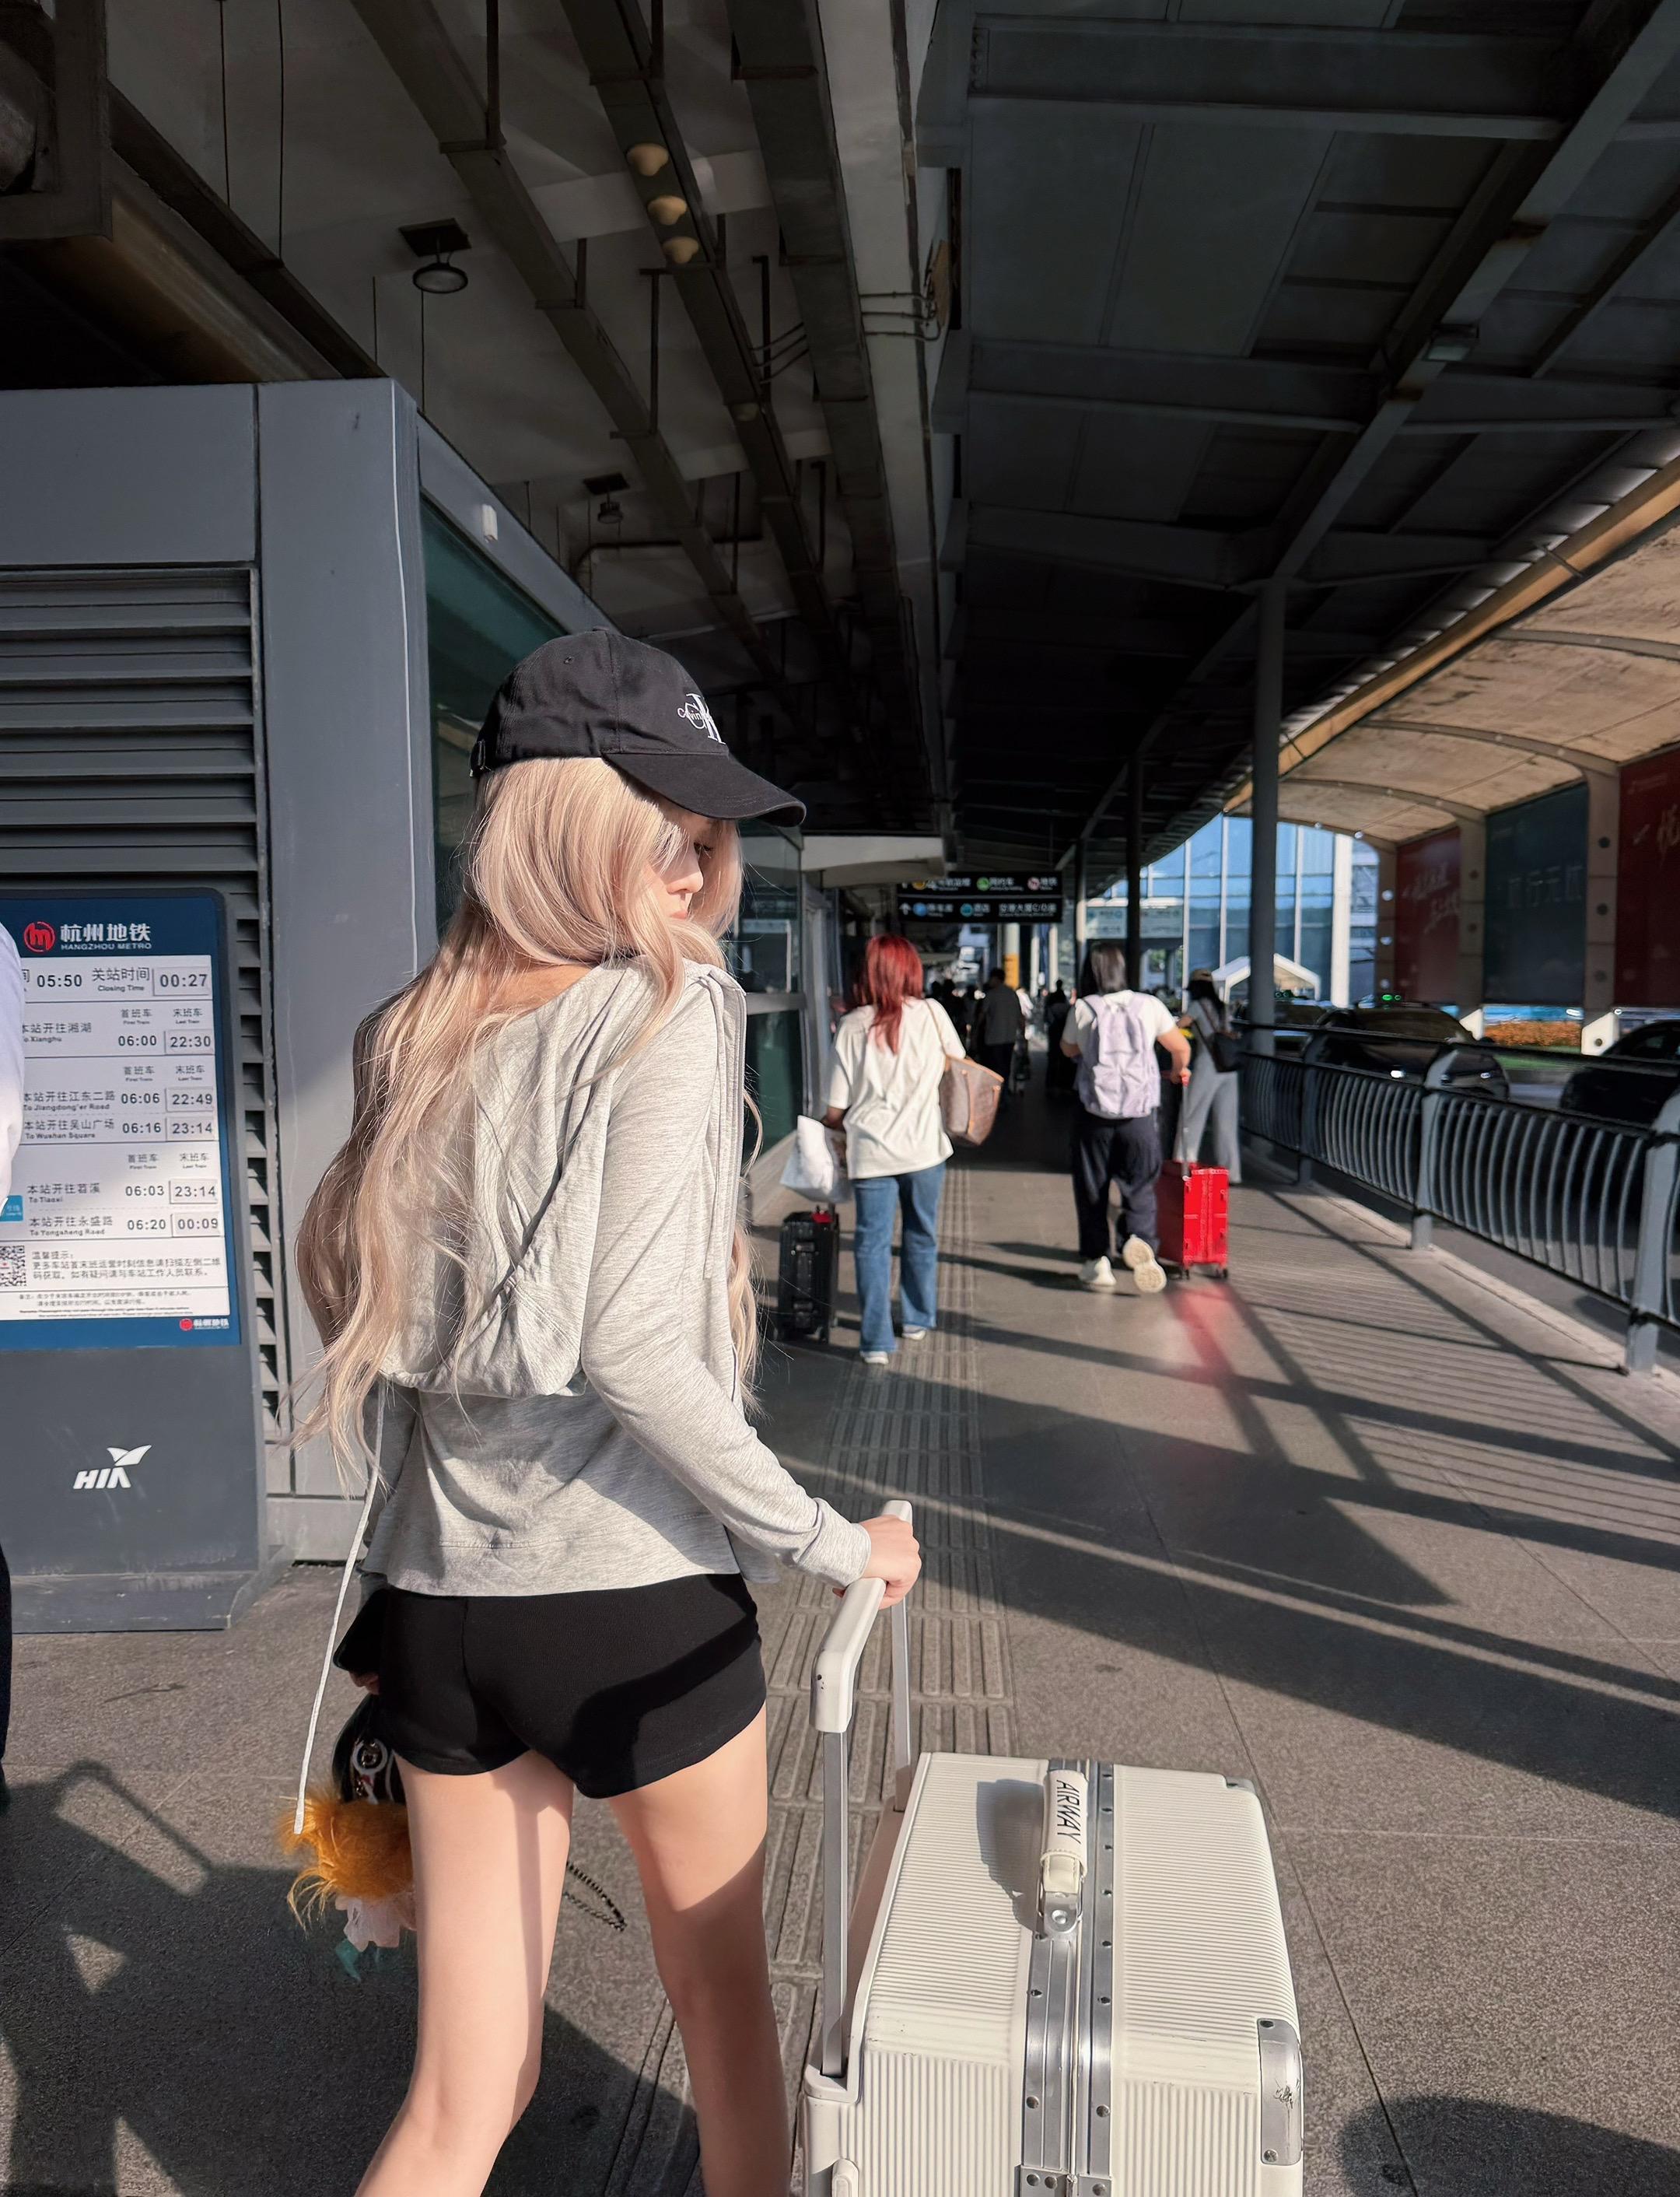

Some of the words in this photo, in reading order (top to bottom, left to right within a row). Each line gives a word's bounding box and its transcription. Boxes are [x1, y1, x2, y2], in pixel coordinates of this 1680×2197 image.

[61, 923, 151, 942] 杭州地铁
[92, 967, 150, 982] 关站时间
[159, 974, 208, 987] 00:27
[37, 974, 82, 988] 05:50
[118, 1035, 157, 1046] 06:00
[170, 1035, 211, 1047] 22:30
[121, 1093, 160, 1104] 06:06
[172, 1093, 213, 1105] 22:49
[122, 1122, 162, 1134] 06:16
[172, 1123, 212, 1134] 23:14
[125, 1186, 165, 1197] 06:03
[175, 1186, 216, 1197] 23:14
[128, 1219, 166, 1230] 06:20
[178, 1218, 219, 1229] 00:09
[1056, 1779, 1082, 1845] AIRWAY
